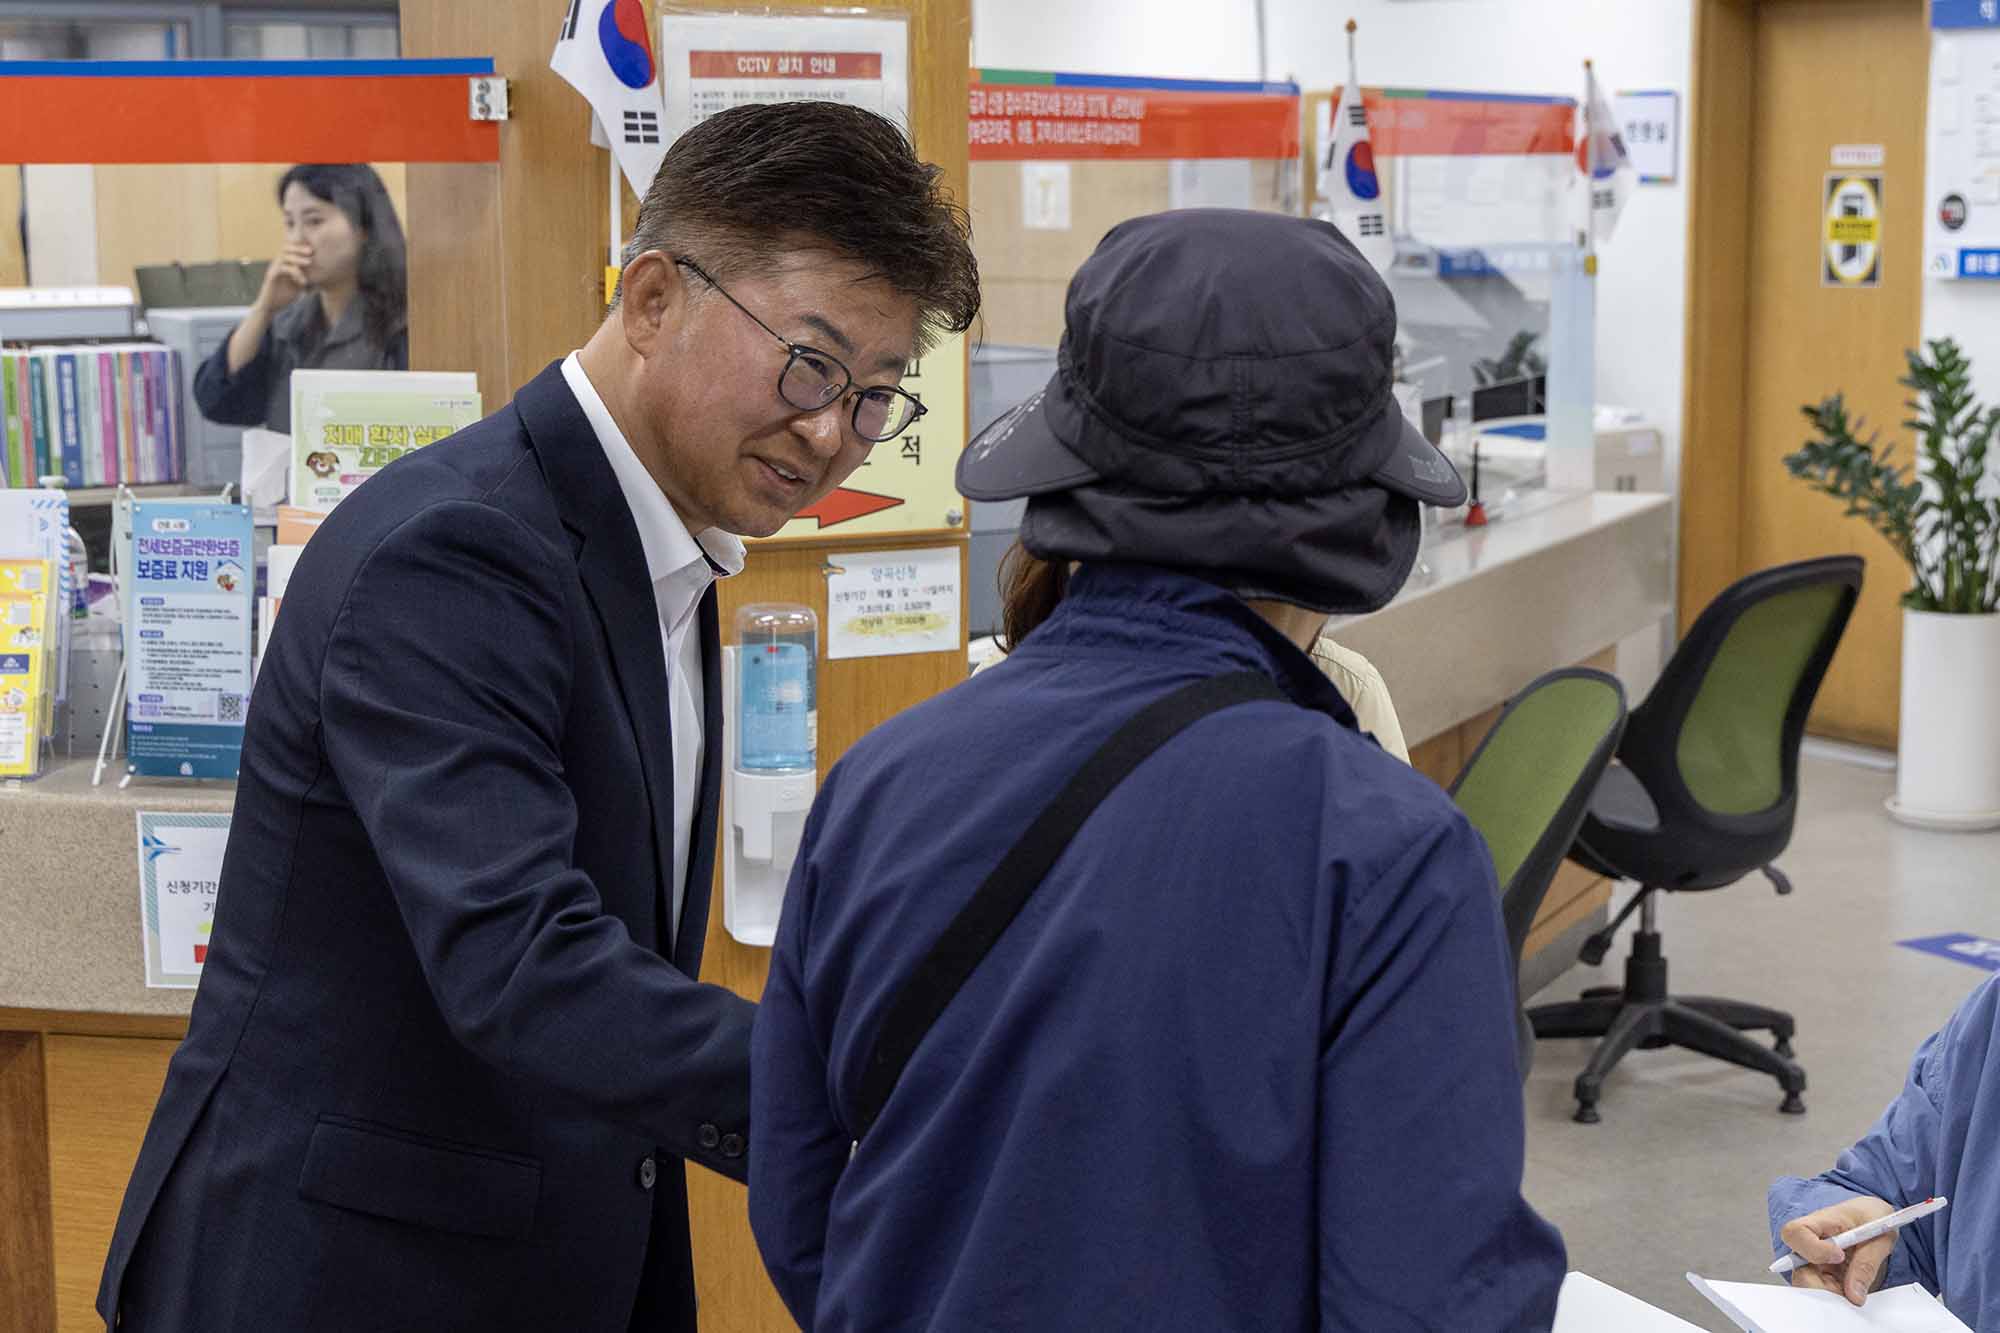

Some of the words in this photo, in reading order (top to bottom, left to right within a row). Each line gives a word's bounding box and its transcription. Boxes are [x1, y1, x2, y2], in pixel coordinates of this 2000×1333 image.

[737, 56, 771, 74] CCTV
[777, 56, 803, 74] 설치
[810, 56, 836, 75] 안내
[323, 424, 364, 447] 치매
[367, 424, 408, 447] 환자
[138, 538, 240, 557] 전세보증금반환보증
[137, 559, 178, 580] 보증료
[181, 559, 208, 581] 지원
[166, 880, 217, 895] 신청기간
